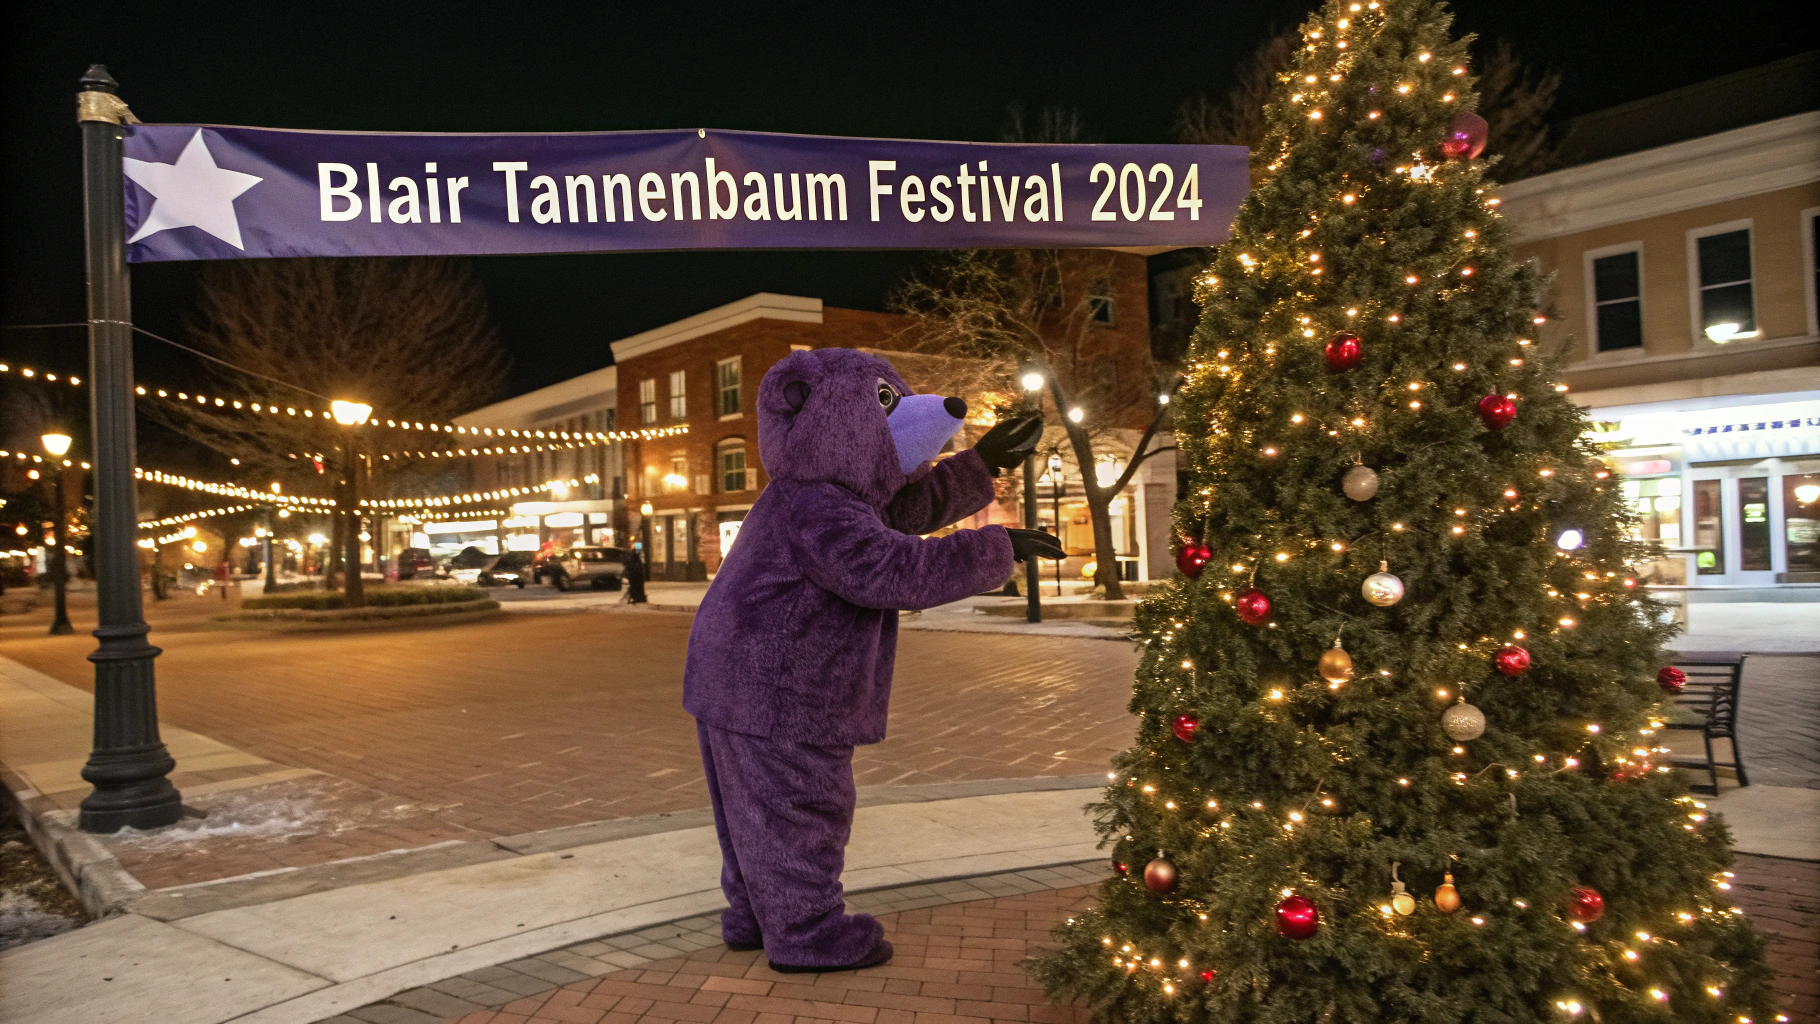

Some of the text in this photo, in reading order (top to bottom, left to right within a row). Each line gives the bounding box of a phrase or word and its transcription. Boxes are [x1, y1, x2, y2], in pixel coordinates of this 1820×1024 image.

[317, 157, 1203, 224] Blair Tannenbaum Festival 2024
